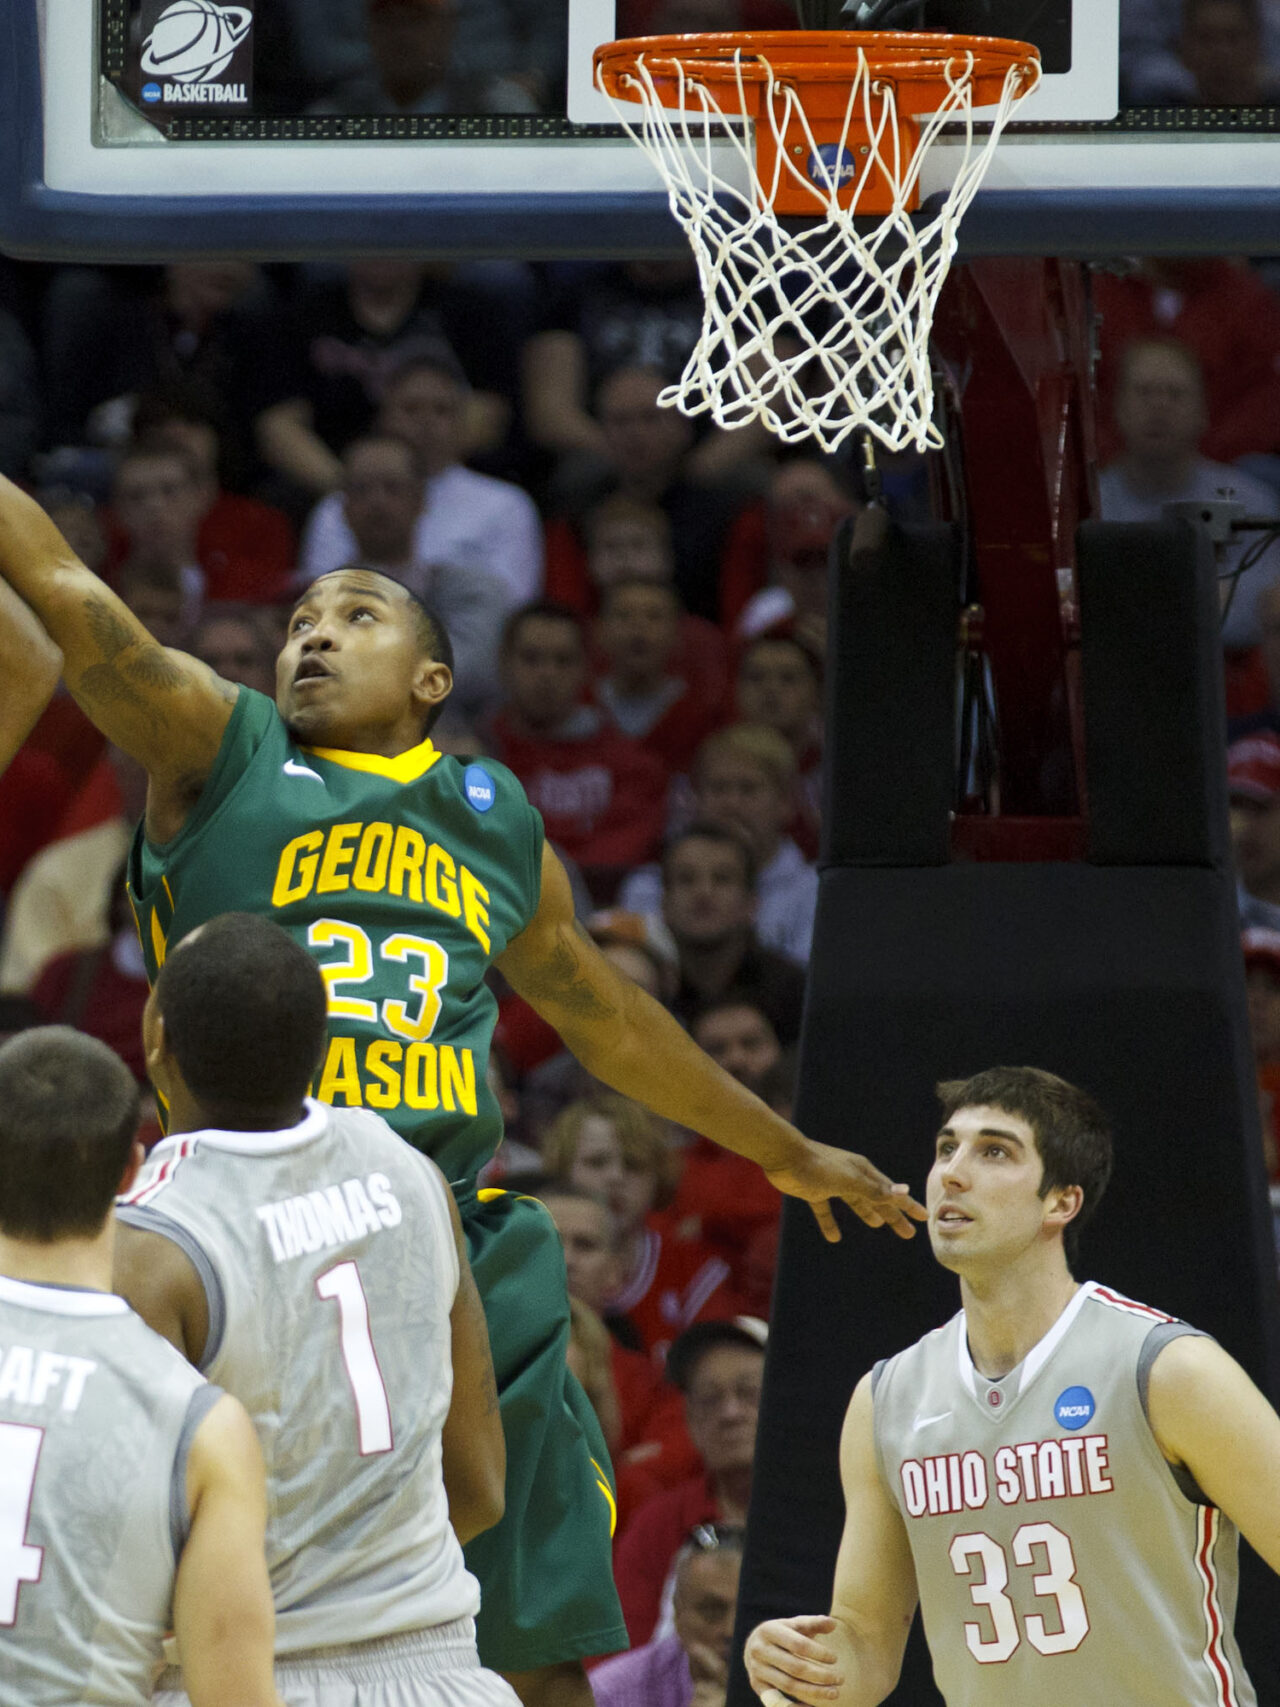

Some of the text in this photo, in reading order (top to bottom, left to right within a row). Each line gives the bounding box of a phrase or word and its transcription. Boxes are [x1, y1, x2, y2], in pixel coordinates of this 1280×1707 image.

[163, 83, 248, 102] BASKETBALL
[468, 785, 492, 801] NCAA
[271, 821, 491, 955] GEORGE
[308, 918, 449, 1042] 23
[317, 1036, 478, 1116] ASON
[256, 1172, 403, 1263] THOMAS
[315, 1259, 394, 1456] 1
[1059, 1405, 1090, 1417] NCAA
[900, 1434, 1115, 1518] OHIO STATE
[948, 1521, 1091, 1665] 33
